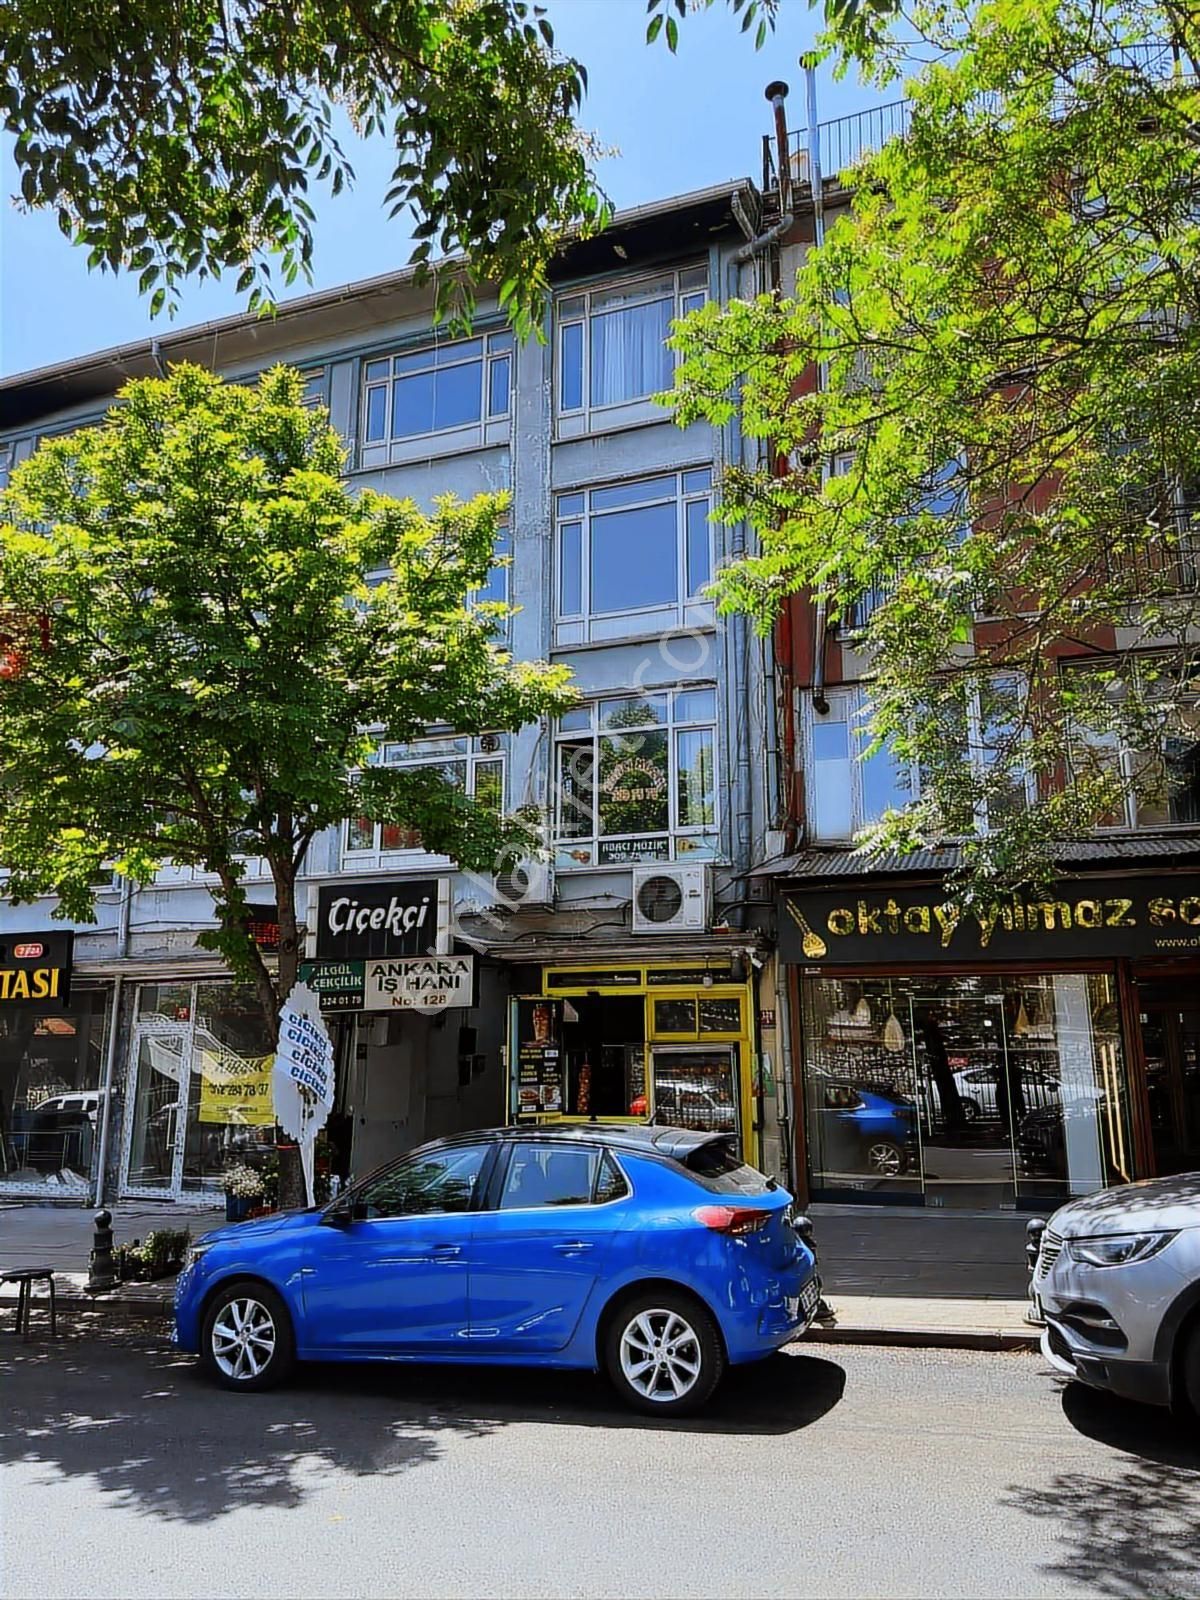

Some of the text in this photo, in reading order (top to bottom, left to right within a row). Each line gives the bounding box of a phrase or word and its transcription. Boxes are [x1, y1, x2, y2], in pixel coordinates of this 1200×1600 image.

[328, 896, 430, 937] Çiçekçi
[827, 899, 959, 948] oktay
[371, 960, 469, 977] ANKARA
[406, 975, 461, 991] HANI
[422, 995, 447, 1006] 128
